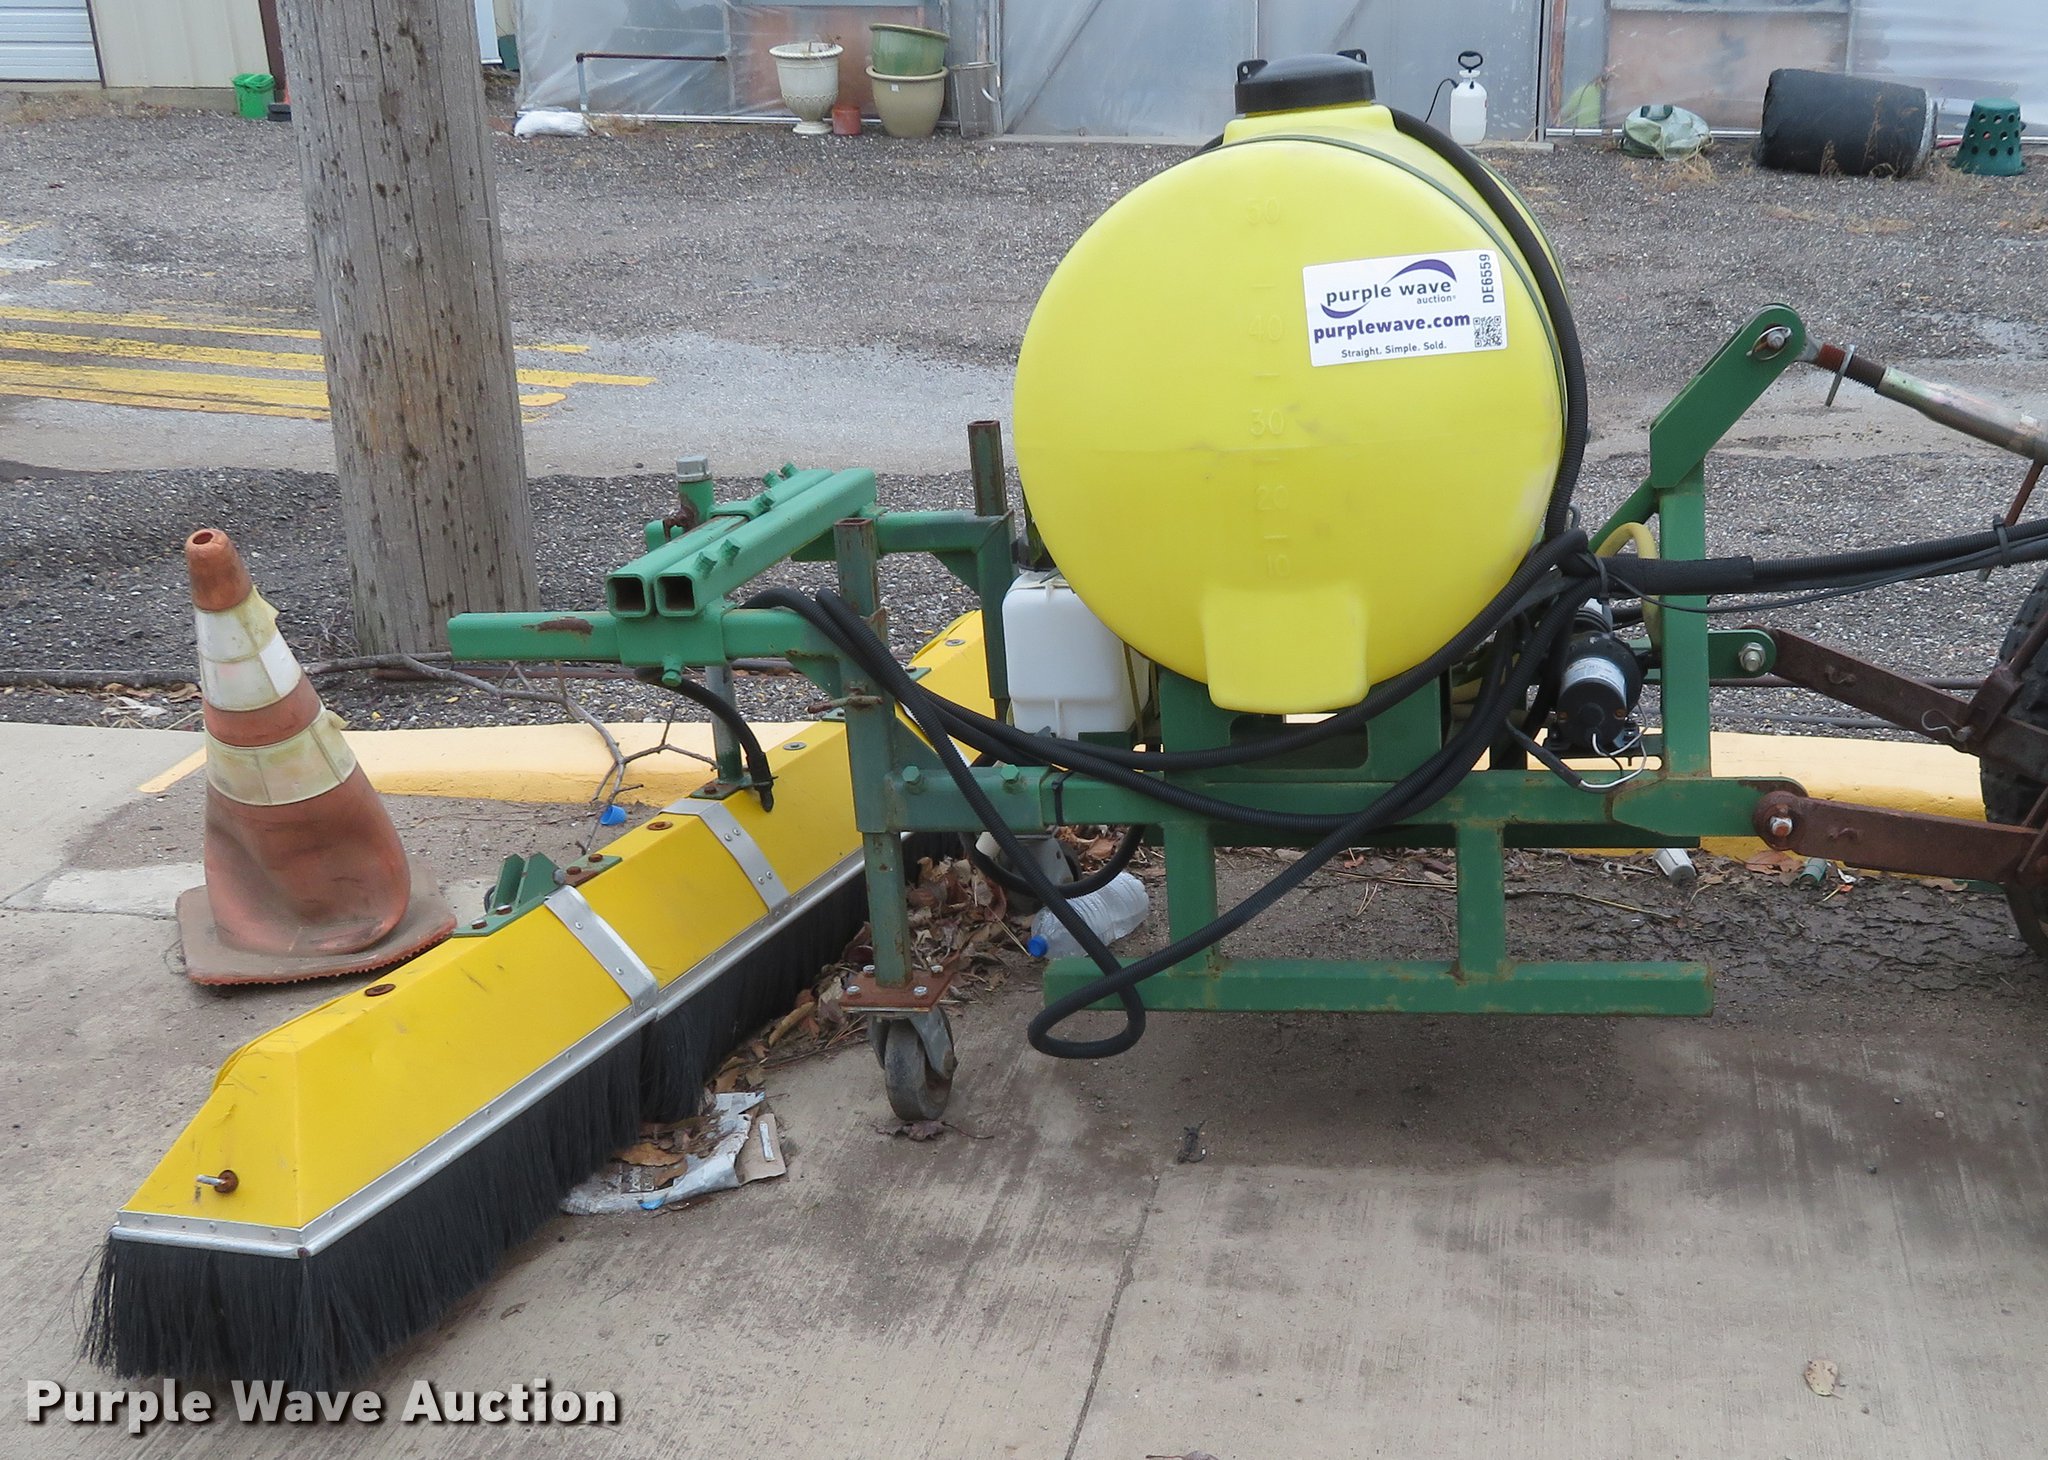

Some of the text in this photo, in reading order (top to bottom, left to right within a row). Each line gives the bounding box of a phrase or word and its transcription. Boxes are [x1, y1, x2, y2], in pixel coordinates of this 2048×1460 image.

[1246, 196, 1281, 225] 50
[1478, 253, 1495, 304] DE6559
[1326, 280, 1452, 306] purple wave
[1248, 314, 1283, 342] 40
[1313, 313, 1471, 344] purplewave.com
[1341, 340, 1447, 359] Straight. Simple. Sold.
[1250, 408, 1285, 436] 30
[1256, 485, 1290, 511] 20
[1266, 553, 1291, 578] 10
